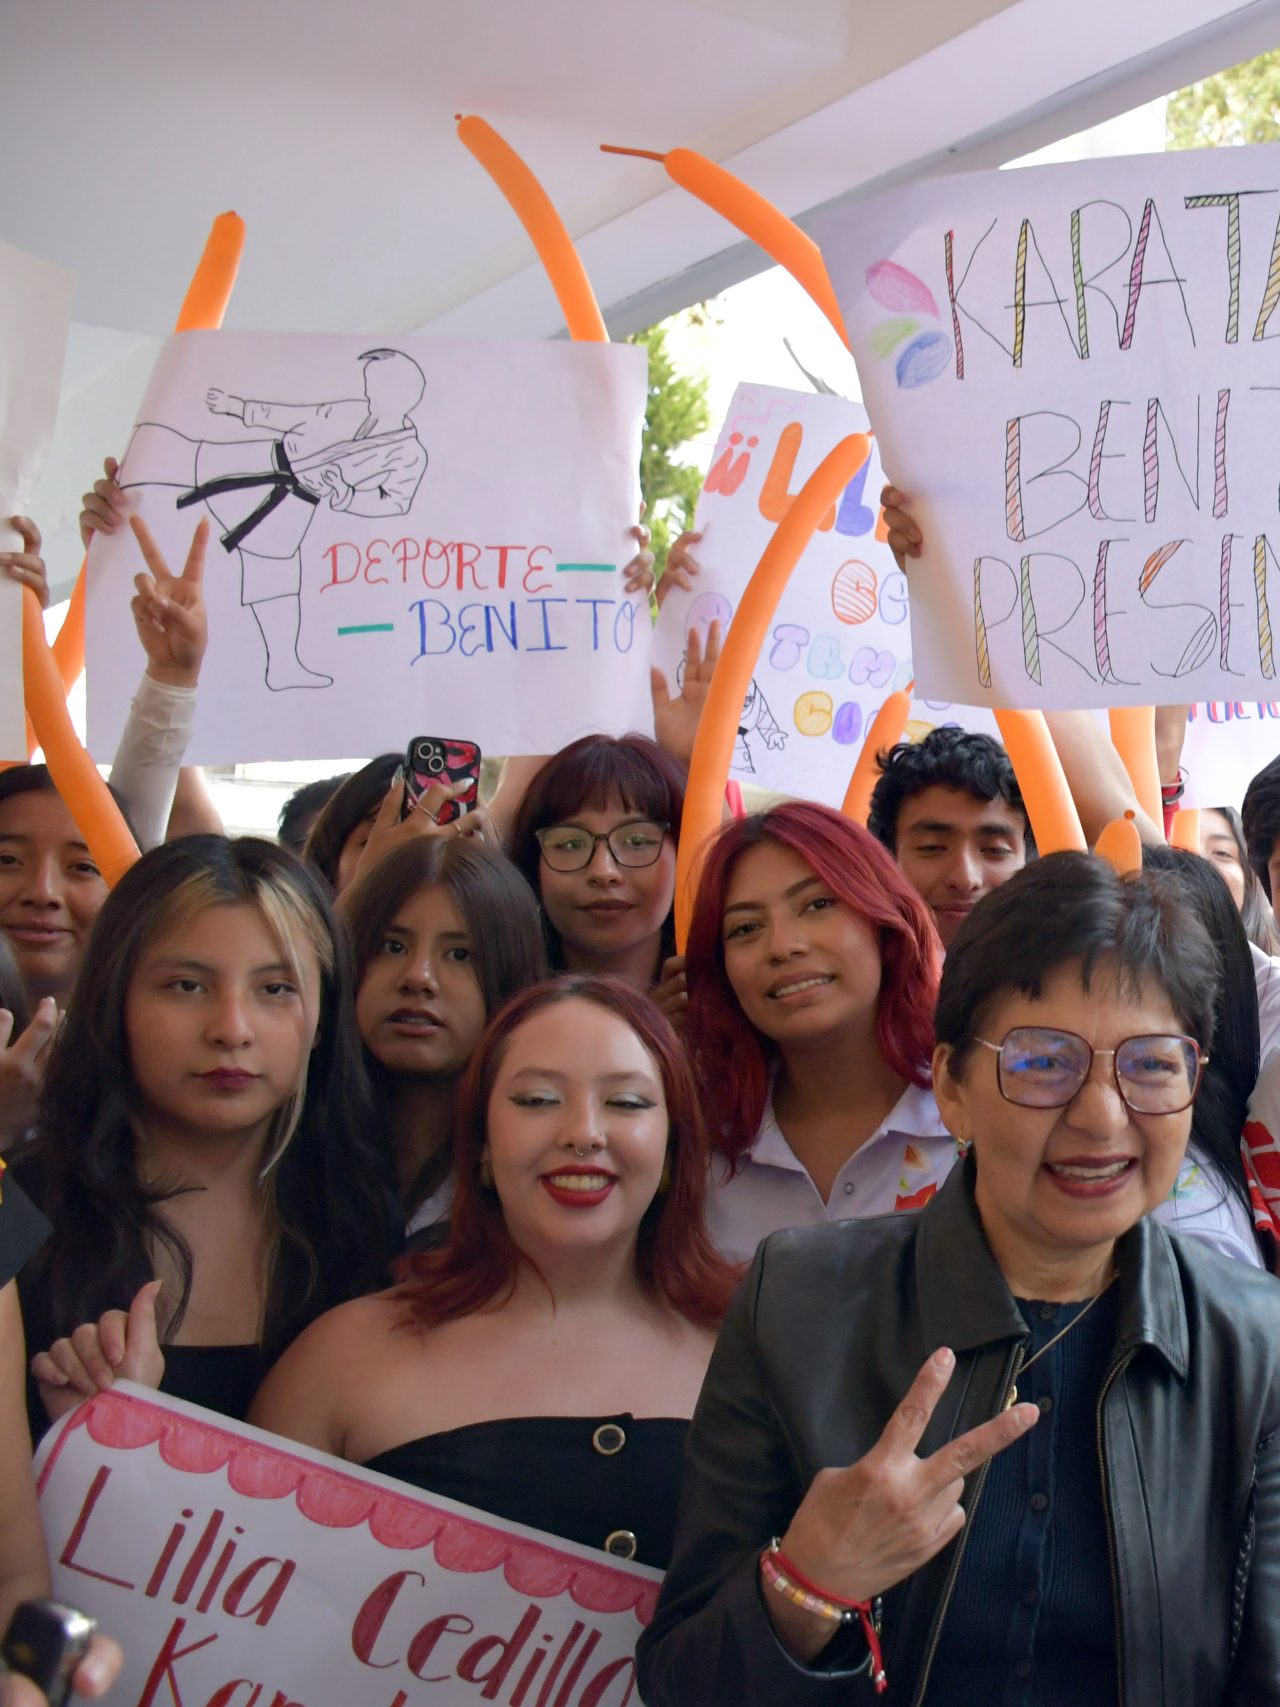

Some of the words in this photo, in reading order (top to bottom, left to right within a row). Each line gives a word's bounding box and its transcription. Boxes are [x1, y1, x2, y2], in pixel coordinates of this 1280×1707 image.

[320, 537, 554, 594] DEPORTE
[409, 598, 641, 666] BENITO
[59, 1465, 296, 1627] Lilia
